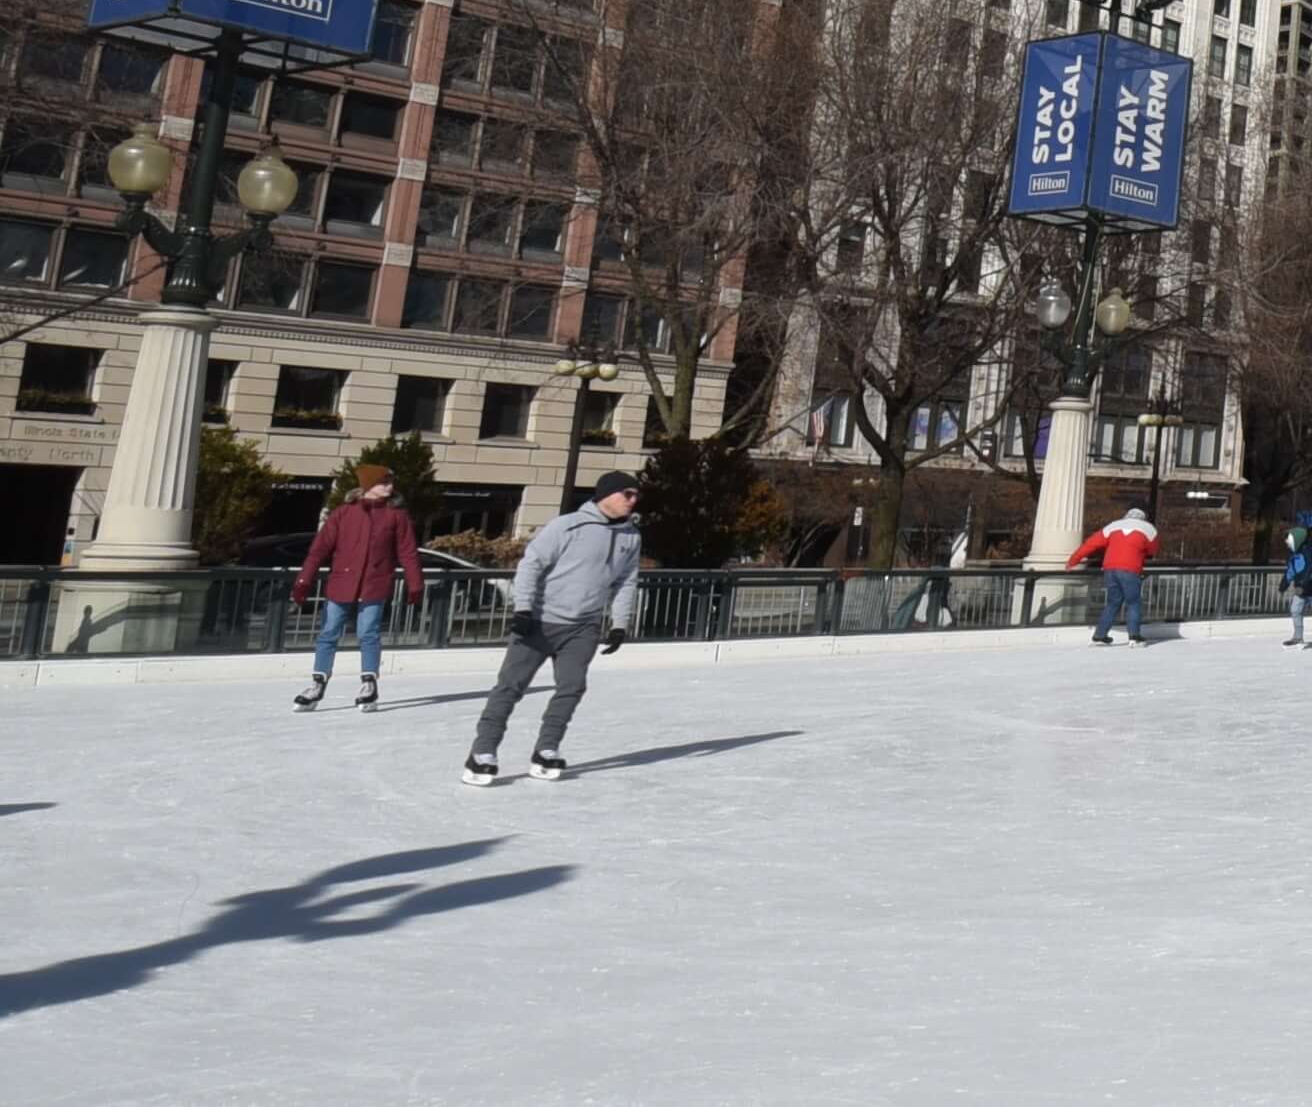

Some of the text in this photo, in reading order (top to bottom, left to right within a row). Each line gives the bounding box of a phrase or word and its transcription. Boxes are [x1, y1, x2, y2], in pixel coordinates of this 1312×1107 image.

[1033, 85, 1056, 165] STAY
[1055, 54, 1082, 162] LOCAL
[1114, 84, 1141, 169] STAY
[1140, 69, 1169, 173] WARM
[1032, 176, 1066, 192] Hilton
[1114, 179, 1154, 201] Hilton
